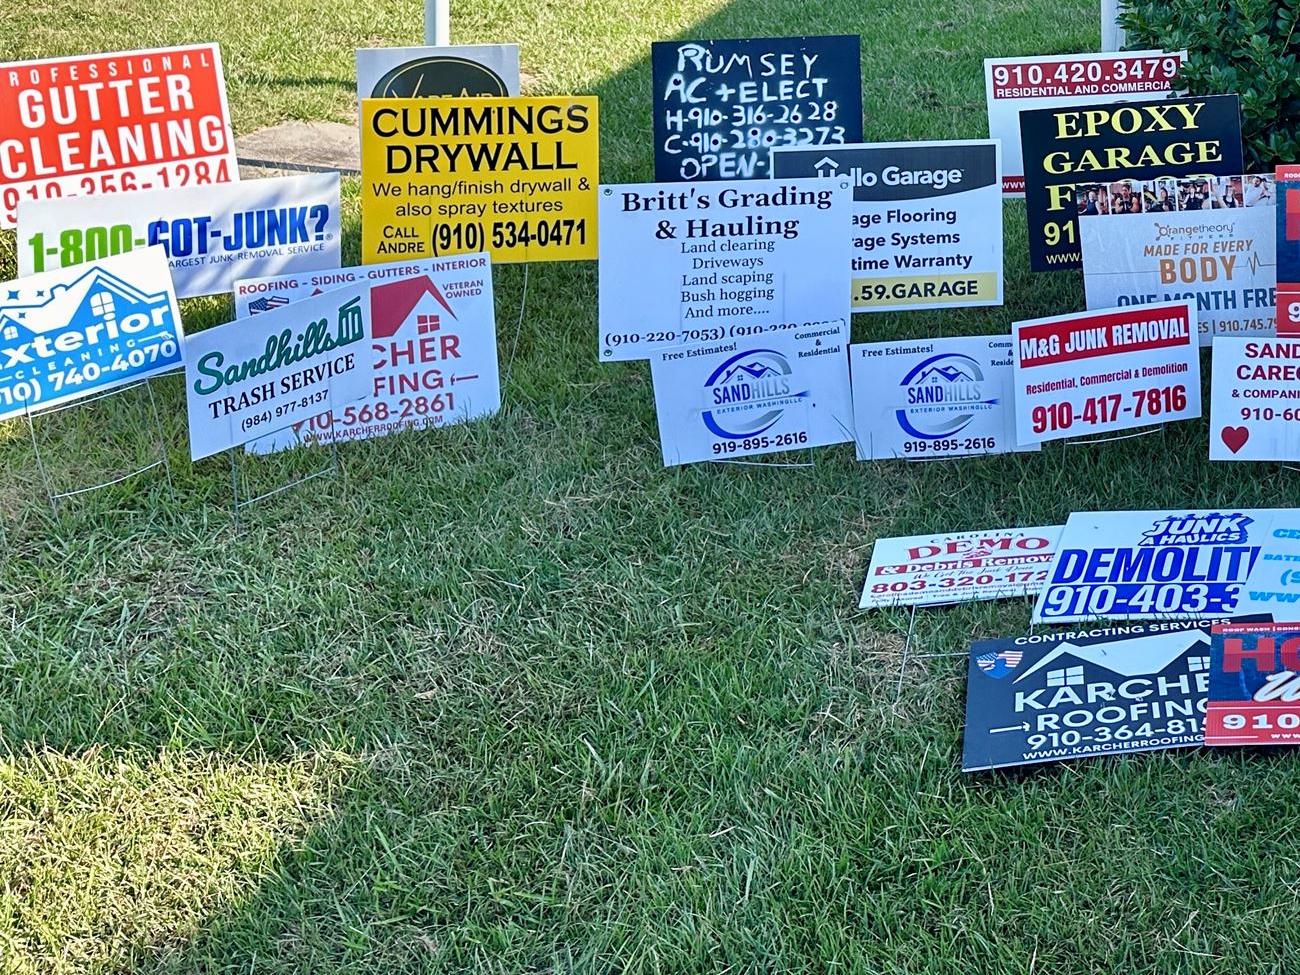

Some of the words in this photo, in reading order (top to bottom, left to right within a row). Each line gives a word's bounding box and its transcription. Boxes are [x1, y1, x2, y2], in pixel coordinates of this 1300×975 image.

[9, 53, 210, 87] ROFESSIONAL
[677, 42, 819, 78] RUMSEY
[994, 58, 1178, 86] 910.420.3479
[664, 72, 708, 104] AC
[738, 78, 828, 104] ELECT
[996, 86, 1072, 98] RESIDENTIAL
[1074, 84, 1099, 95] AND
[1101, 80, 1172, 93] COMMERCIA
[18, 74, 195, 129] GUTTER
[372, 104, 590, 138] CUMMINGS
[1053, 102, 1206, 140] EPOXY
[0, 115, 225, 180] CLEANING
[386, 141, 579, 174] DRYWALL
[1042, 140, 1223, 174] GARAGE
[372, 182, 402, 197] We
[407, 180, 504, 199] hang/finish
[510, 178, 572, 196] drywall
[881, 165, 962, 189] Garage
[395, 202, 432, 217] also
[438, 201, 487, 219] spray
[493, 199, 564, 214] textures
[621, 186, 711, 212] Britt's
[717, 184, 833, 210] Grading
[685, 215, 800, 239] Hauling
[886, 207, 957, 225] Flooring
[28, 204, 330, 273] 1-800-GOT-JUNK?
[383, 225, 419, 238] CALL
[431, 222, 486, 257] (910)
[492, 218, 587, 248] 534-0471
[890, 231, 961, 249] Systems
[237, 247, 286, 260] REMOVAL
[288, 242, 326, 254] SERVICE
[377, 240, 425, 254] ANDRE
[680, 241, 717, 254] Land
[719, 239, 776, 253] clearing
[1144, 243, 1180, 257] MADE
[1184, 242, 1209, 255] FOR
[1213, 239, 1254, 253] EVERY
[692, 256, 764, 270] Driveways
[893, 252, 973, 271] Warranty
[1159, 254, 1237, 285] BODY
[239, 278, 299, 295] ROOFING
[311, 272, 356, 287] SIDING
[368, 265, 420, 280] GUTTERS
[432, 258, 487, 272] INTERIOR
[442, 280, 484, 291] VETERAN
[682, 273, 718, 286] Land
[721, 271, 774, 285] scaping
[445, 288, 482, 300] OWNED
[680, 289, 715, 303] Bush
[719, 286, 775, 301] hogging
[684, 306, 713, 319] And
[0, 302, 169, 369] xterior
[1020, 334, 1061, 361] M&G
[1065, 326, 1109, 353] JUNK
[1112, 317, 1189, 346] REMOVAL
[193, 318, 339, 395] Sandhills
[662, 351, 685, 361] Free
[686, 342, 738, 358] Estimates!
[862, 349, 882, 358] Free
[48, 340, 177, 391] 740-4070
[1080, 369, 1132, 387] Commercial
[1142, 362, 1188, 377] Demolition
[208, 383, 276, 418] TRASH
[281, 353, 356, 395] SERVICE
[241, 410, 273, 432] (984)
[276, 389, 329, 418] 977-8137
[1032, 384, 1187, 434] 910-417-7816
[712, 431, 808, 454] 919-895-2616
[903, 437, 996, 453] 919-895-2616
[906, 537, 1051, 561] DEMO
[905, 560, 975, 573] Debris
[1051, 546, 1261, 584] DEMOLIT
[1014, 625, 1145, 646] CONTRACTING
[1149, 618, 1232, 632] SERVICES
[1015, 672, 1210, 713] KARCHE
